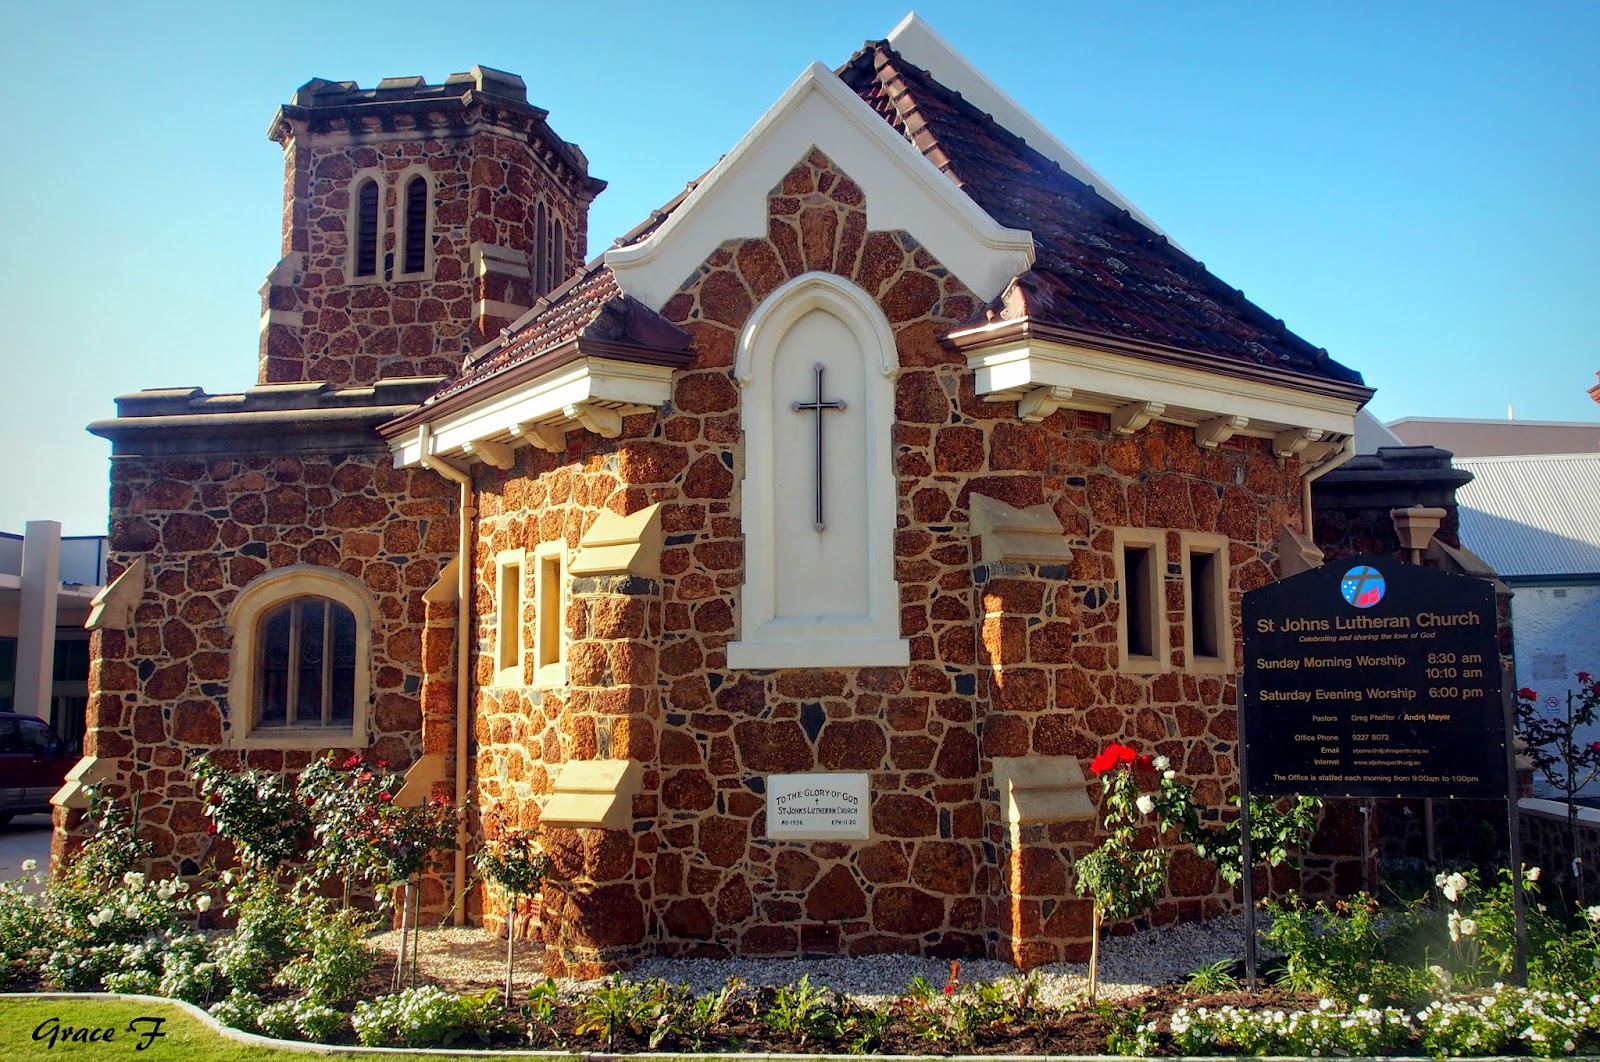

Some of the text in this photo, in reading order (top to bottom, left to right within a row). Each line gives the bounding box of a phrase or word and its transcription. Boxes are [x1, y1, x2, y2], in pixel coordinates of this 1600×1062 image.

[1257, 611, 1480, 633] St Johns Lutheran Church
[1298, 635, 1337, 643] Celebrating
[1353, 633, 1379, 641] sharing
[1380, 632, 1392, 640] the
[1394, 632, 1409, 640] love
[1410, 631, 1419, 639] of
[1420, 631, 1436, 639] God
[1256, 653, 1482, 670] Sunday Morning Worship 8:30 am
[1425, 668, 1483, 679] 10:10 am
[1259, 687, 1484, 702] Saturday Evening Worship 6:00 pm
[1312, 714, 1338, 722] Pastors
[1350, 714, 1369, 723] Greg
[1428, 713, 1451, 722] Meyer
[1294, 734, 1316, 742] Office
[1317, 734, 1339, 742] Phone
[1320, 746, 1340, 754] Email
[1313, 758, 1340, 766] Internet
[1272, 773, 1287, 781] The
[1287, 773, 1309, 781] Office
[1344, 774, 1361, 782] each
[1363, 774, 1392, 783] morning
[1393, 774, 1411, 782] from
[1411, 774, 1440, 783] 9:00am
[776, 788, 859, 806] TO THE GLORY OF GOD
[807, 806, 837, 815] LUTHERAN
[837, 806, 858, 815] CHURCH
